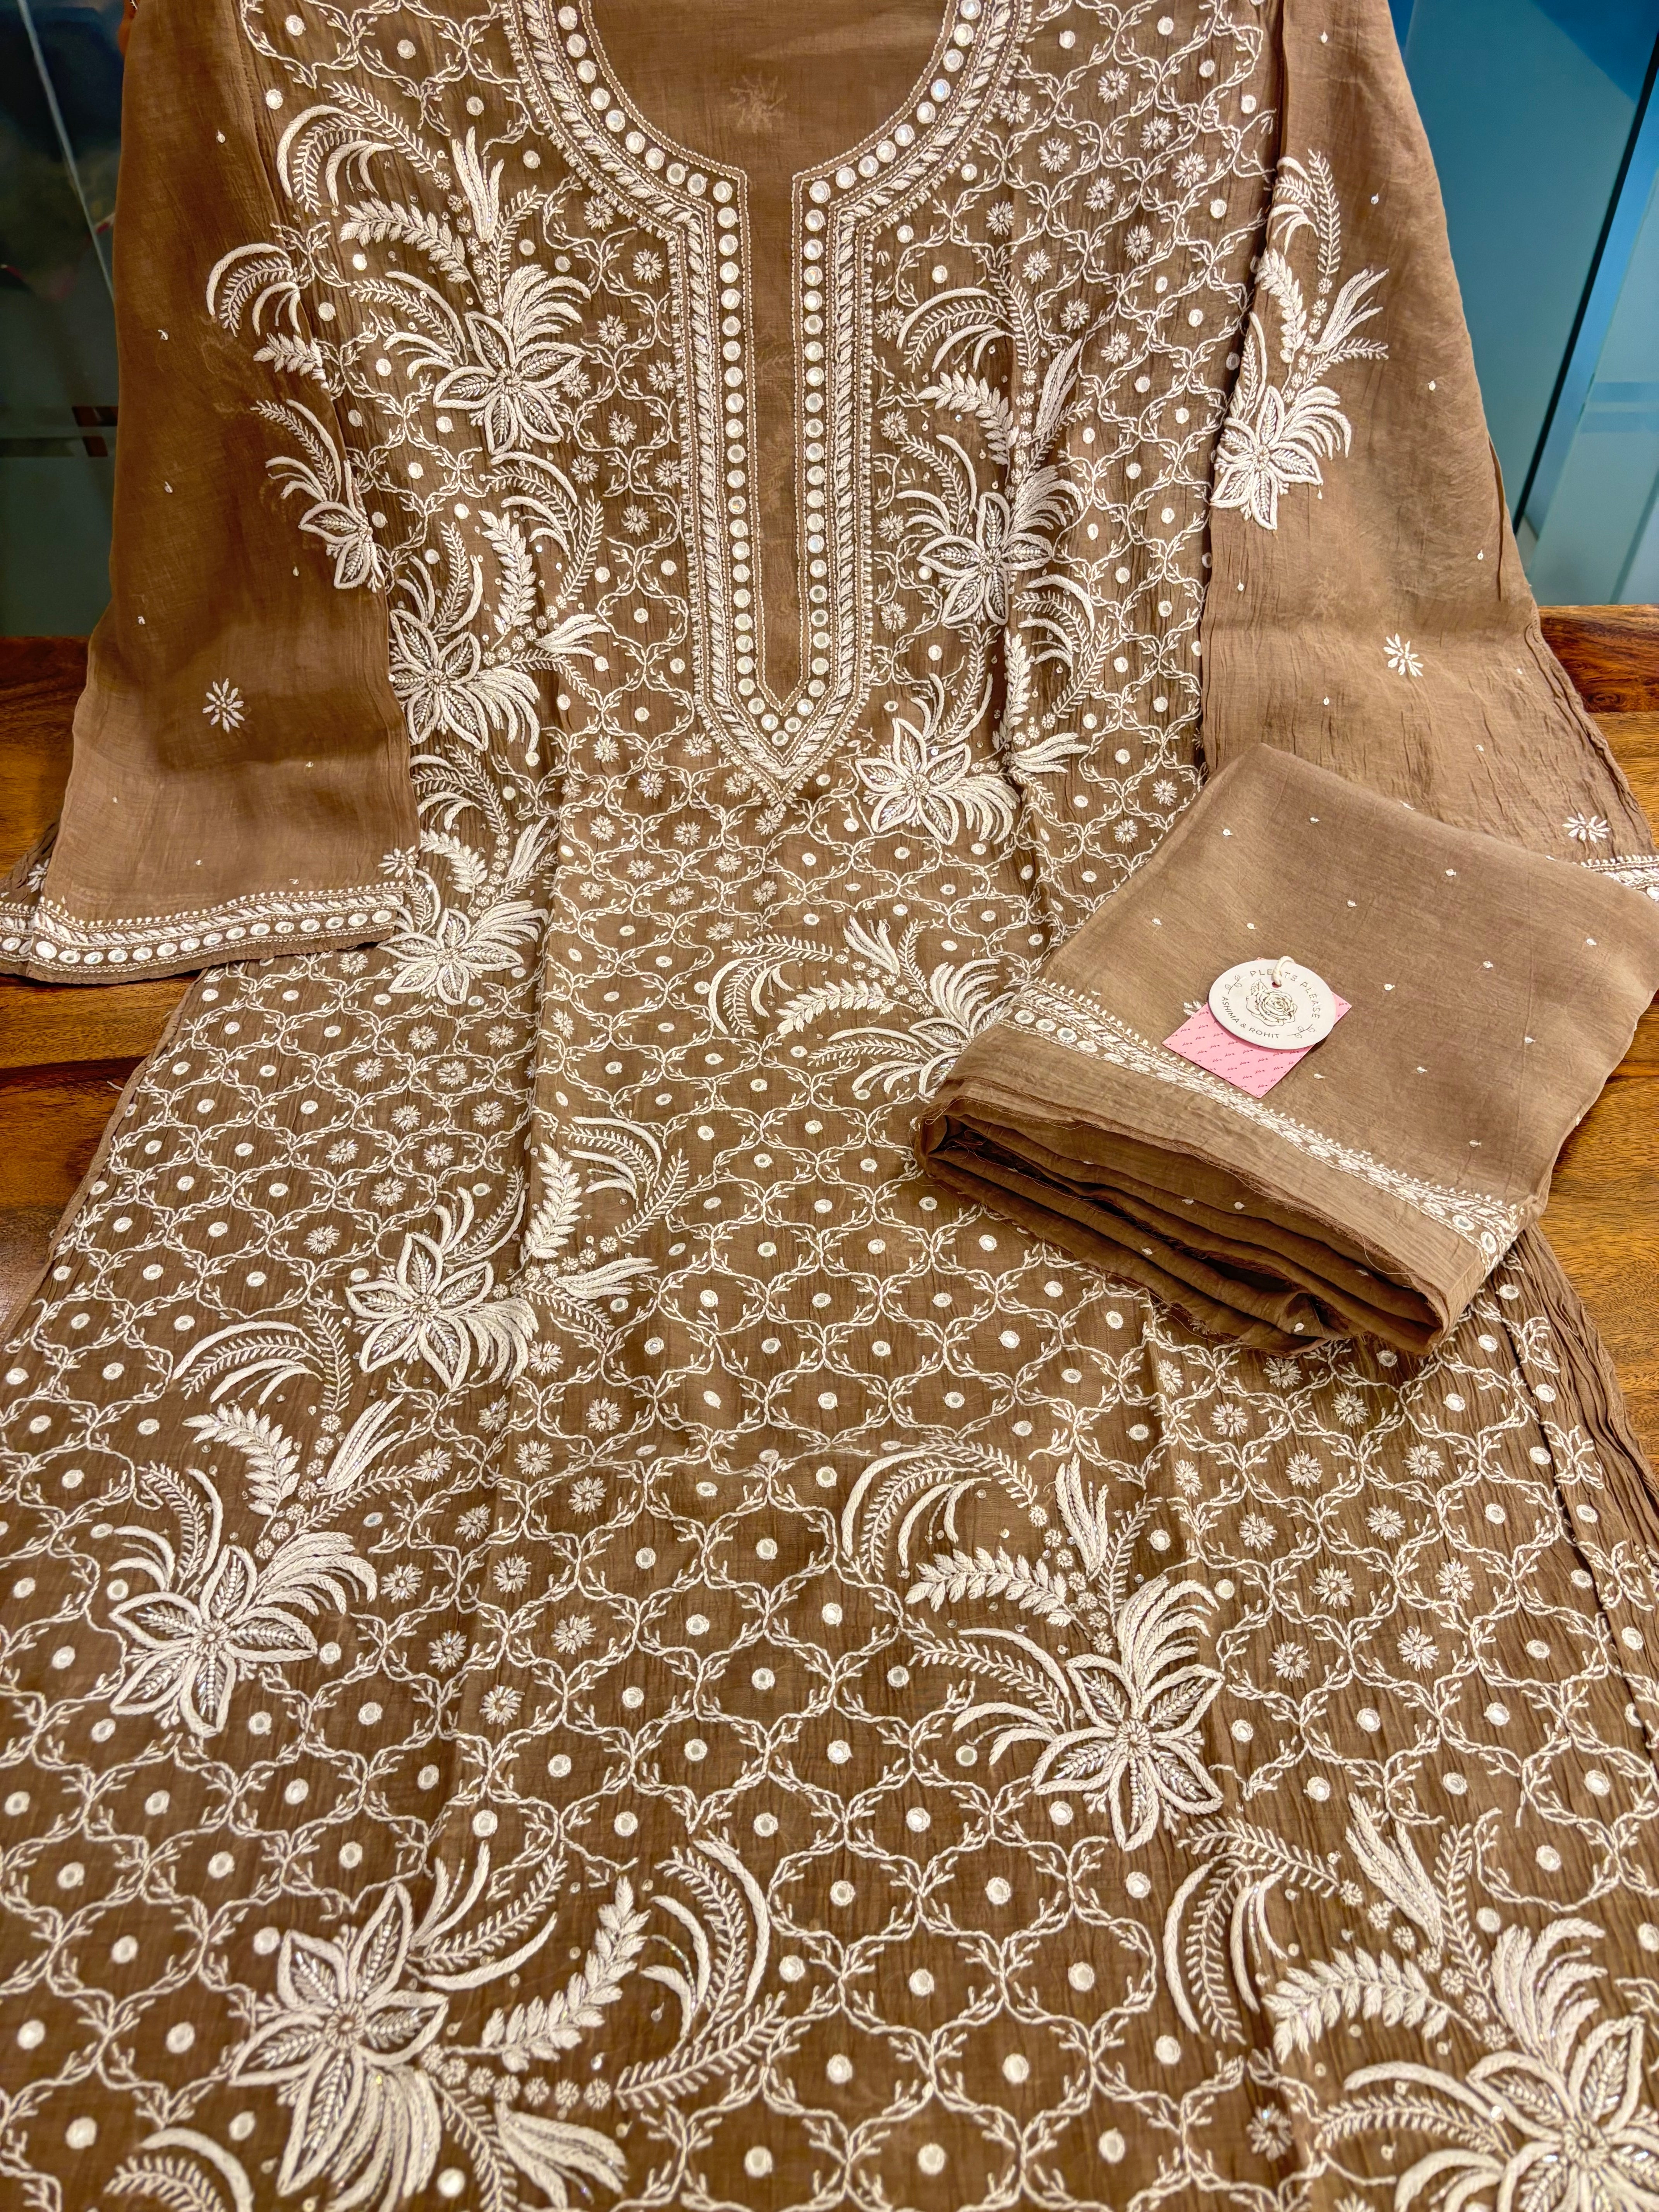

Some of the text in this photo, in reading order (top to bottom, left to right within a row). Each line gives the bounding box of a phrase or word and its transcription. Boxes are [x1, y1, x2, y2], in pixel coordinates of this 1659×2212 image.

[1222, 996, 1240, 1023] ASHIMA
[1249, 1027, 1279, 1038] ROHIT
[1250, 969, 1321, 1019] PLETS PLEASE
